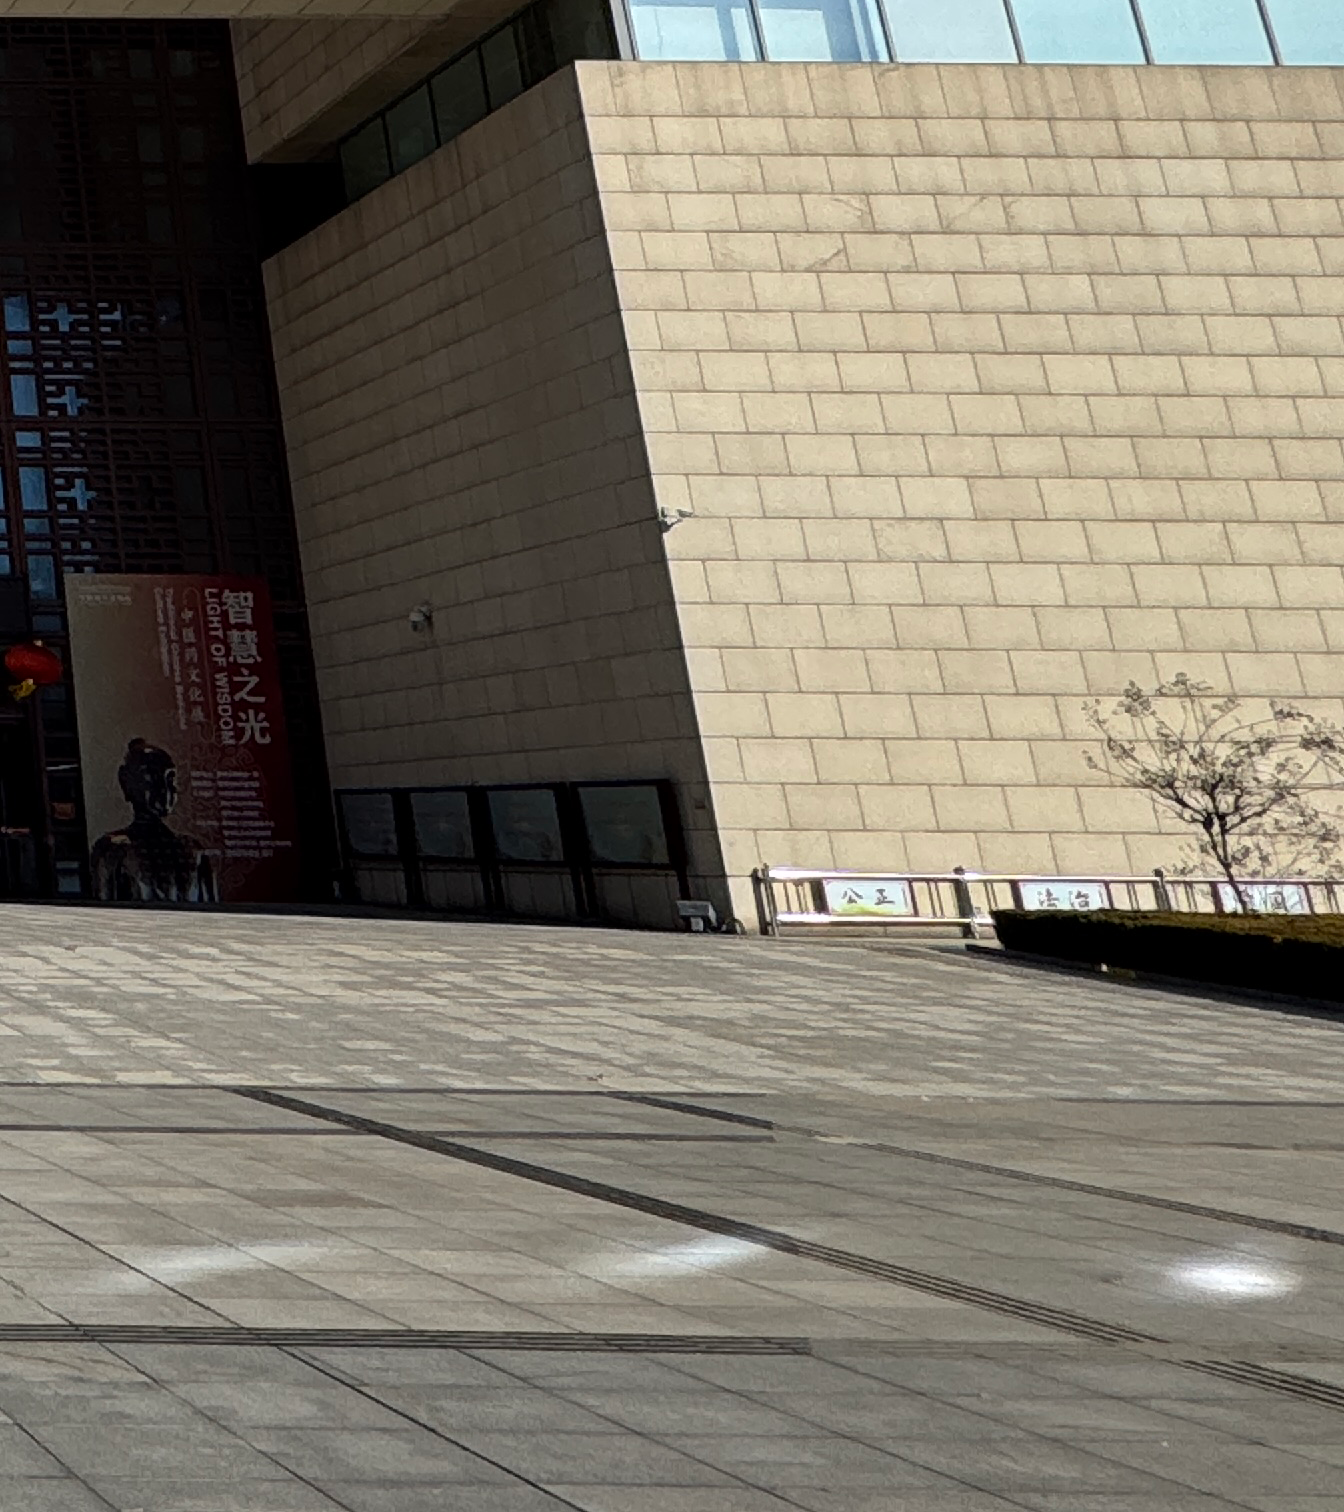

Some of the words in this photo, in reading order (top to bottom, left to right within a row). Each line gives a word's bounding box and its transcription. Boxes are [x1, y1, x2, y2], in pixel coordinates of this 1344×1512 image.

[204, 588, 223, 639] LIGHT
[210, 643, 227, 667] OF
[222, 589, 271, 744] 智慧之光
[214, 671, 236, 746] WISDOM
[841, 887, 896, 906] 公正
[1037, 887, 1089, 908] 法治
